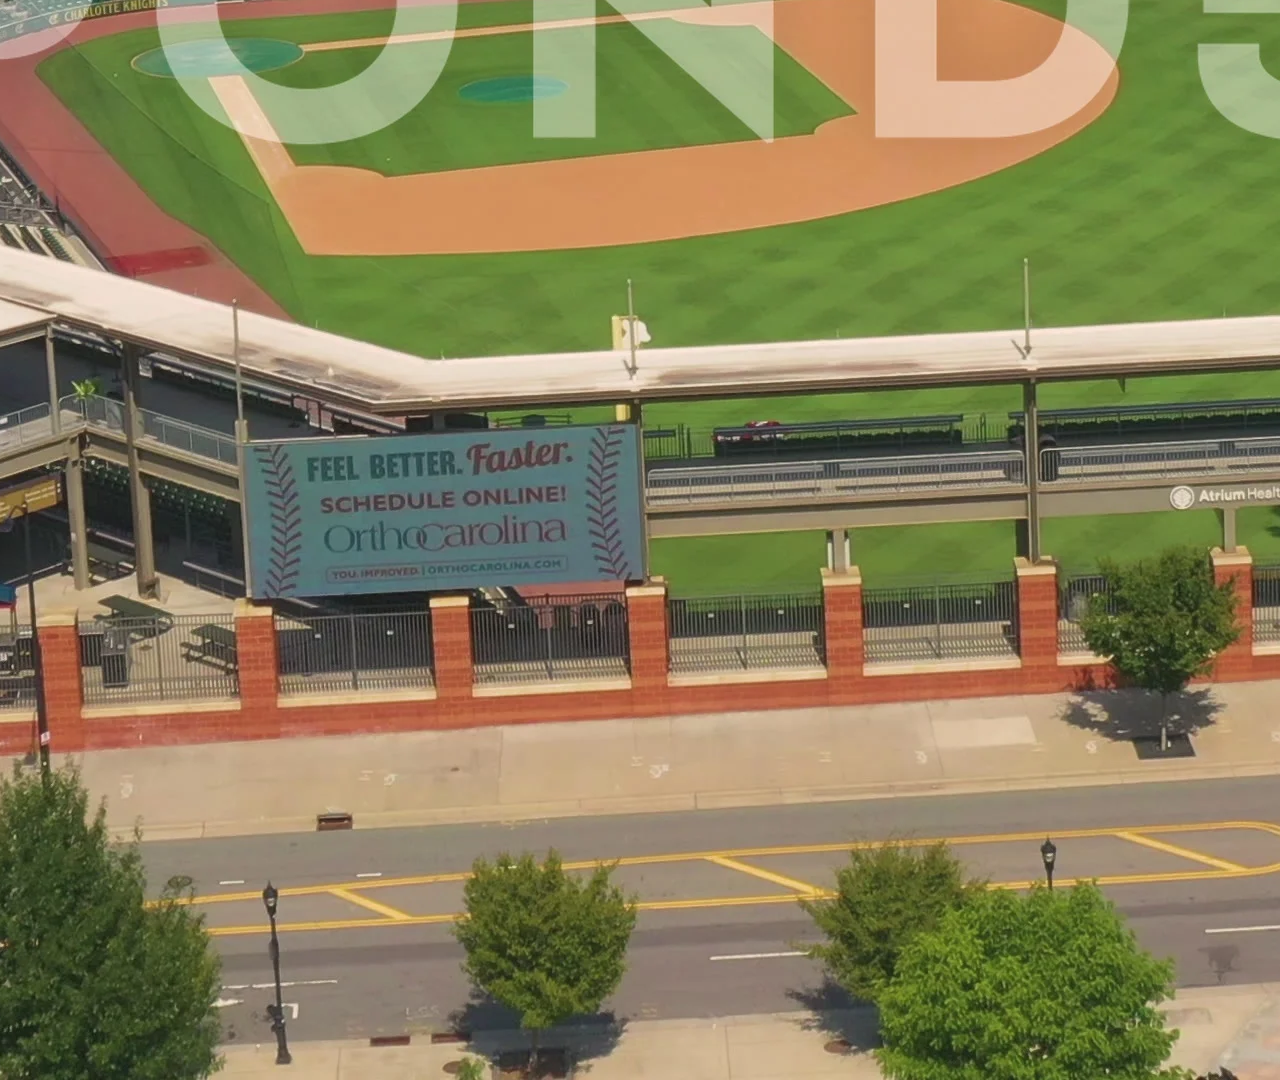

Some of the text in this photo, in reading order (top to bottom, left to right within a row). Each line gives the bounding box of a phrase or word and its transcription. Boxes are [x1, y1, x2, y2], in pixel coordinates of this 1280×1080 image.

[64, 3, 121, 22] CHARLOTTE
[306, 439, 574, 483] FEEL BETTER. Faster.
[320, 484, 567, 515] SCHEDULE ONLINE!
[1199, 488, 1245, 503] Atrium
[323, 514, 567, 554] OrthoCarolina
[427, 558, 563, 577] ORTHOCAROLINA.COM
